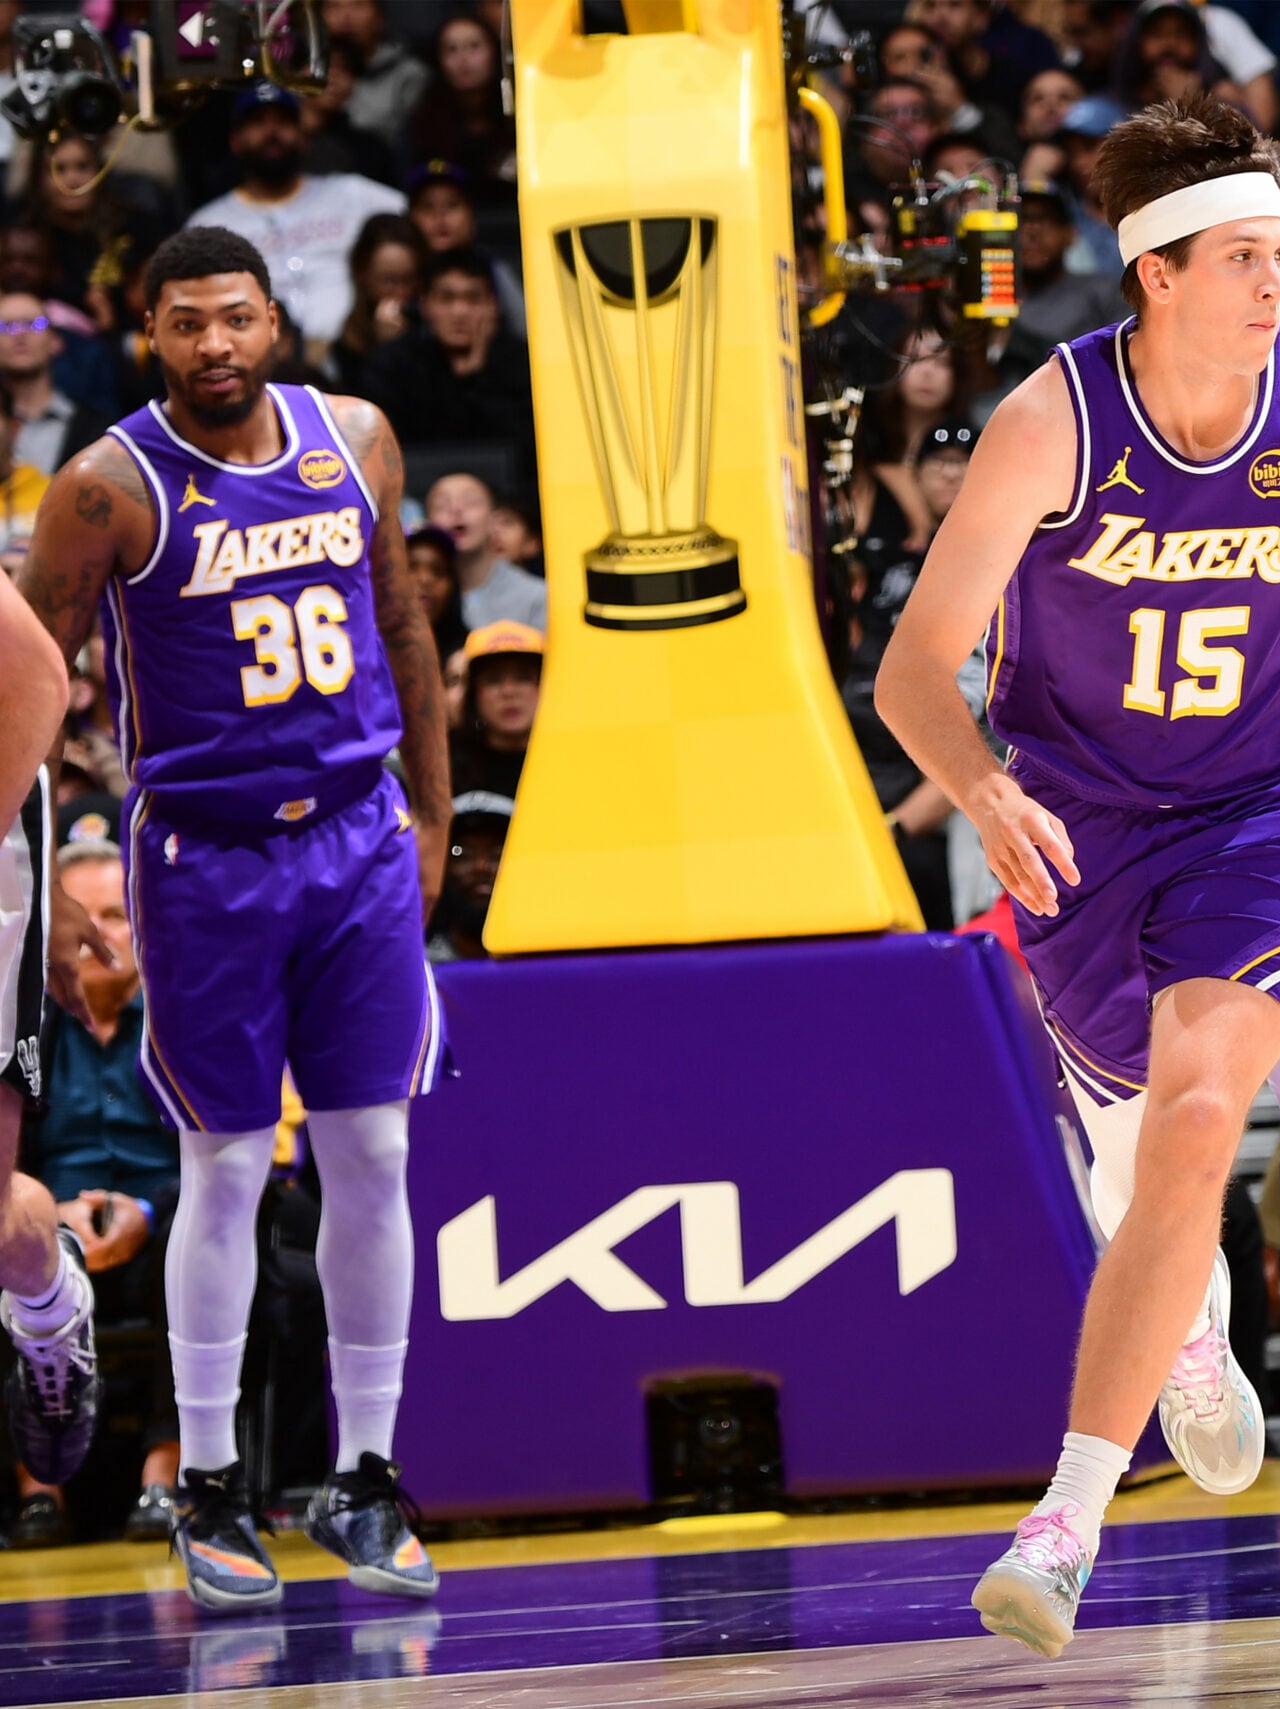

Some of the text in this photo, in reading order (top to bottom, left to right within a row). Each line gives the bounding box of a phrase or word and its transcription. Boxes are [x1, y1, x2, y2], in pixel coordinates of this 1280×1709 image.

[179, 507, 364, 598] LAKERS
[230, 584, 355, 708] 36
[1123, 605, 1250, 721] 15
[437, 1167, 958, 1321] KIA
